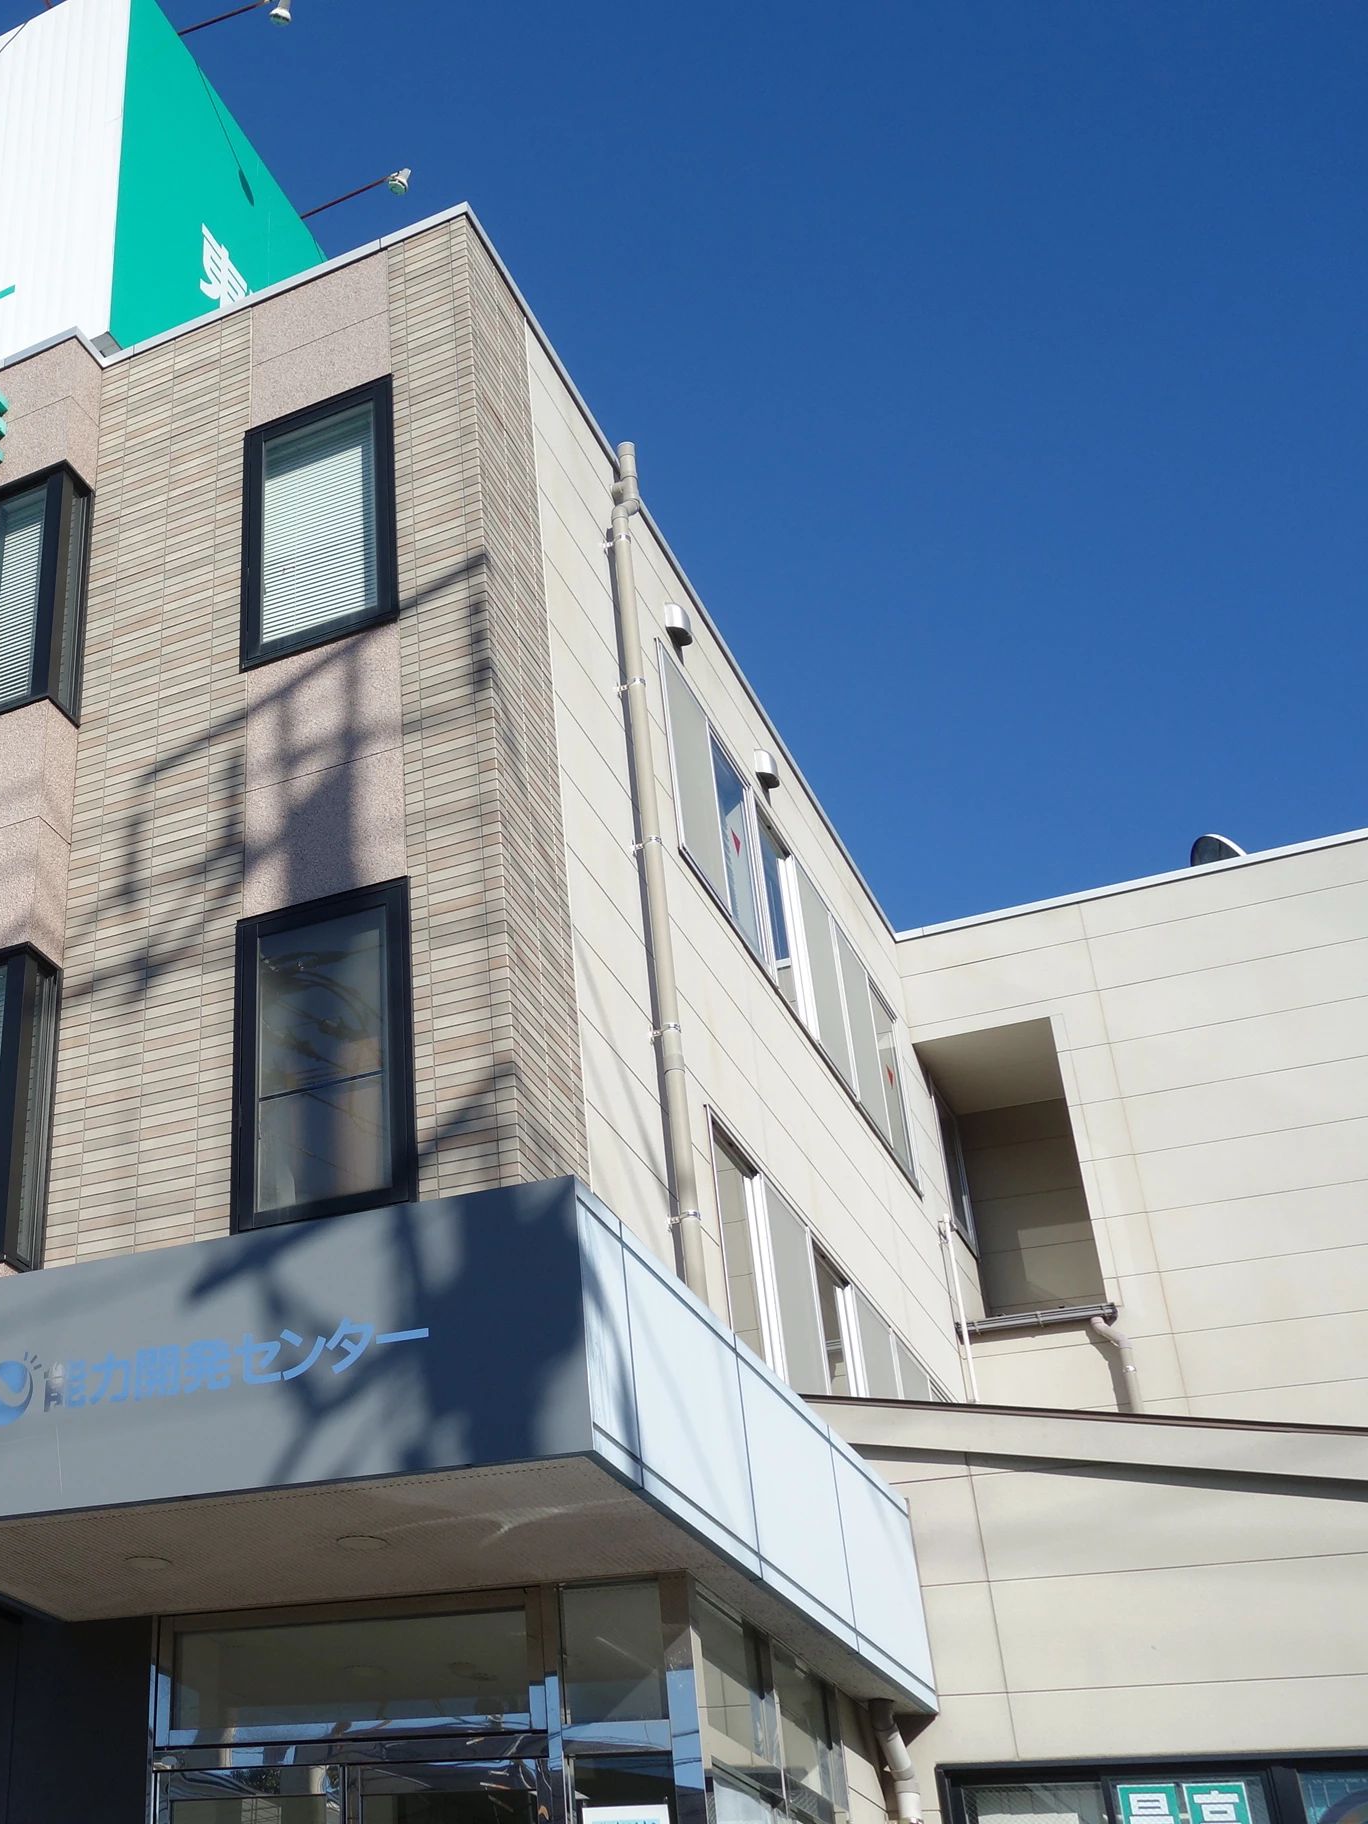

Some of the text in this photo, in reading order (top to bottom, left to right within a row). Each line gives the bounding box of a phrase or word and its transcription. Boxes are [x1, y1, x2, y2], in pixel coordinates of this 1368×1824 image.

[43, 1316, 430, 1413] 能力開発センター
